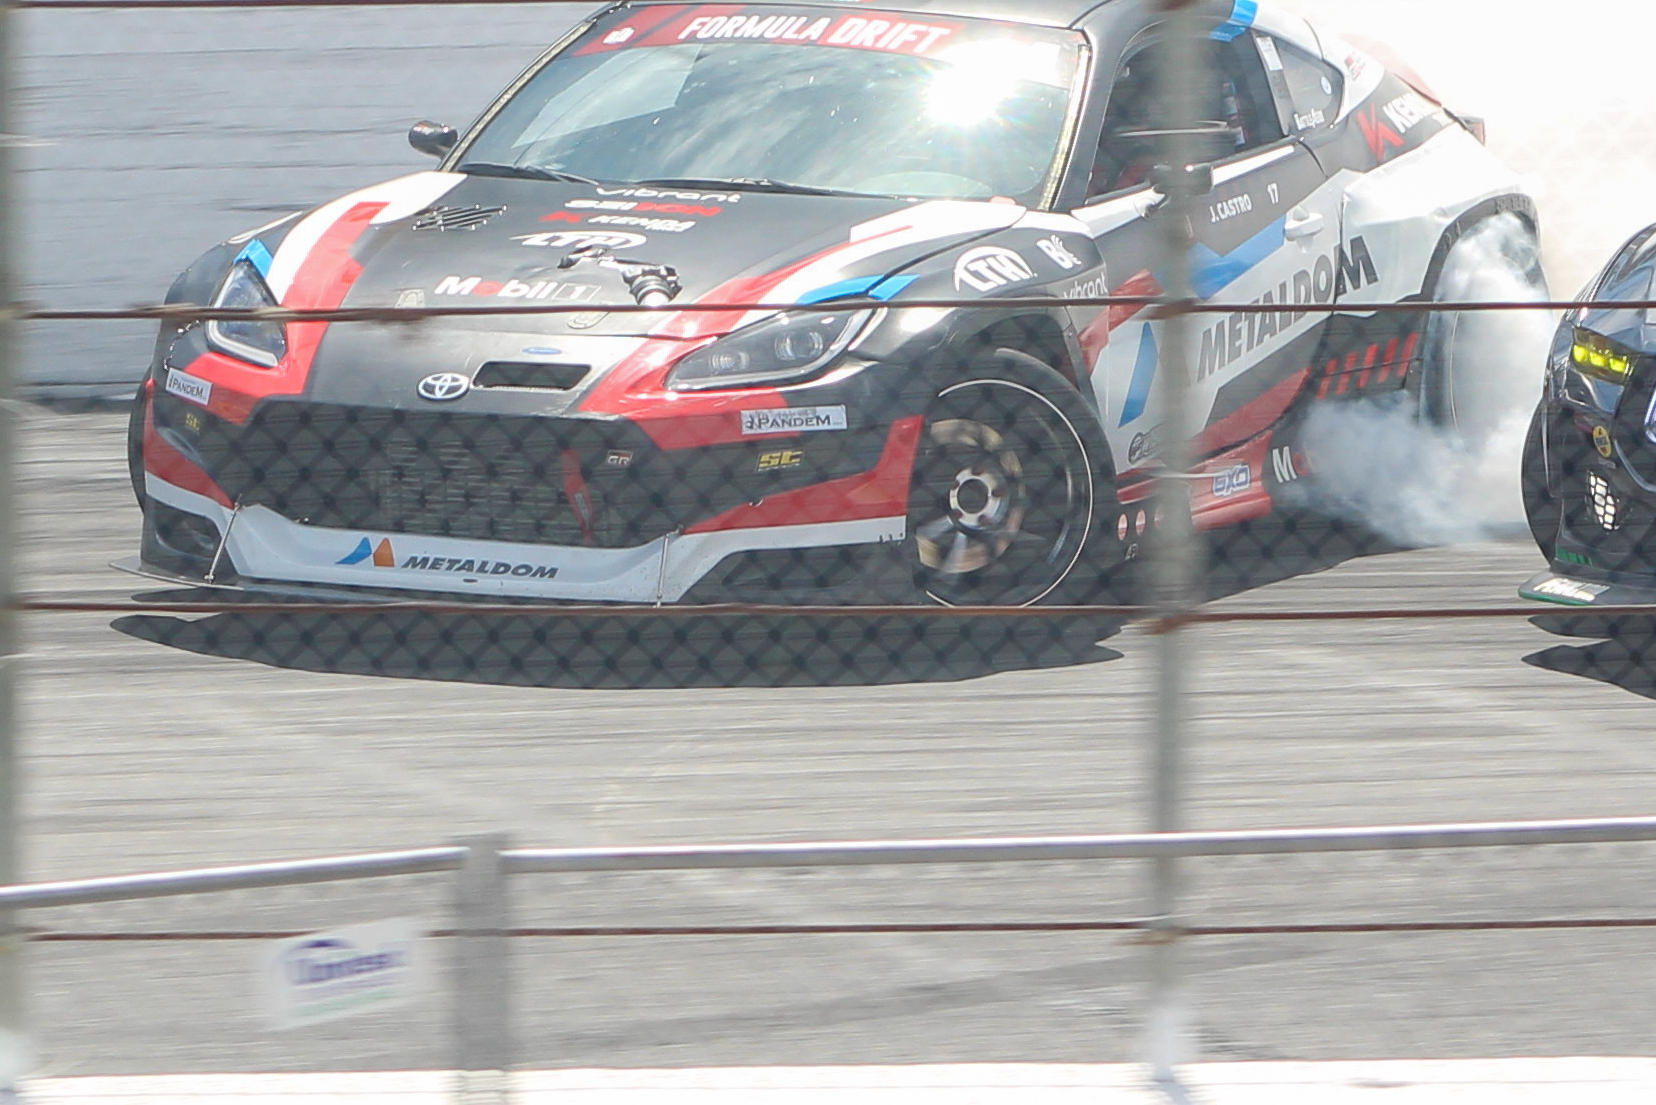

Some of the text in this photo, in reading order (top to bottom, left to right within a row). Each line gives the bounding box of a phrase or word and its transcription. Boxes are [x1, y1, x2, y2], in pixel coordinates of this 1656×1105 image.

[679, 14, 951, 53] FORMULA DRIFT
[596, 186, 741, 203] vibrant
[1267, 183, 1280, 204] 17
[434, 275, 558, 299] Mobil
[1197, 235, 1379, 383] METALDOM
[758, 413, 831, 429] PANDEM
[401, 554, 559, 580] METALDOM
